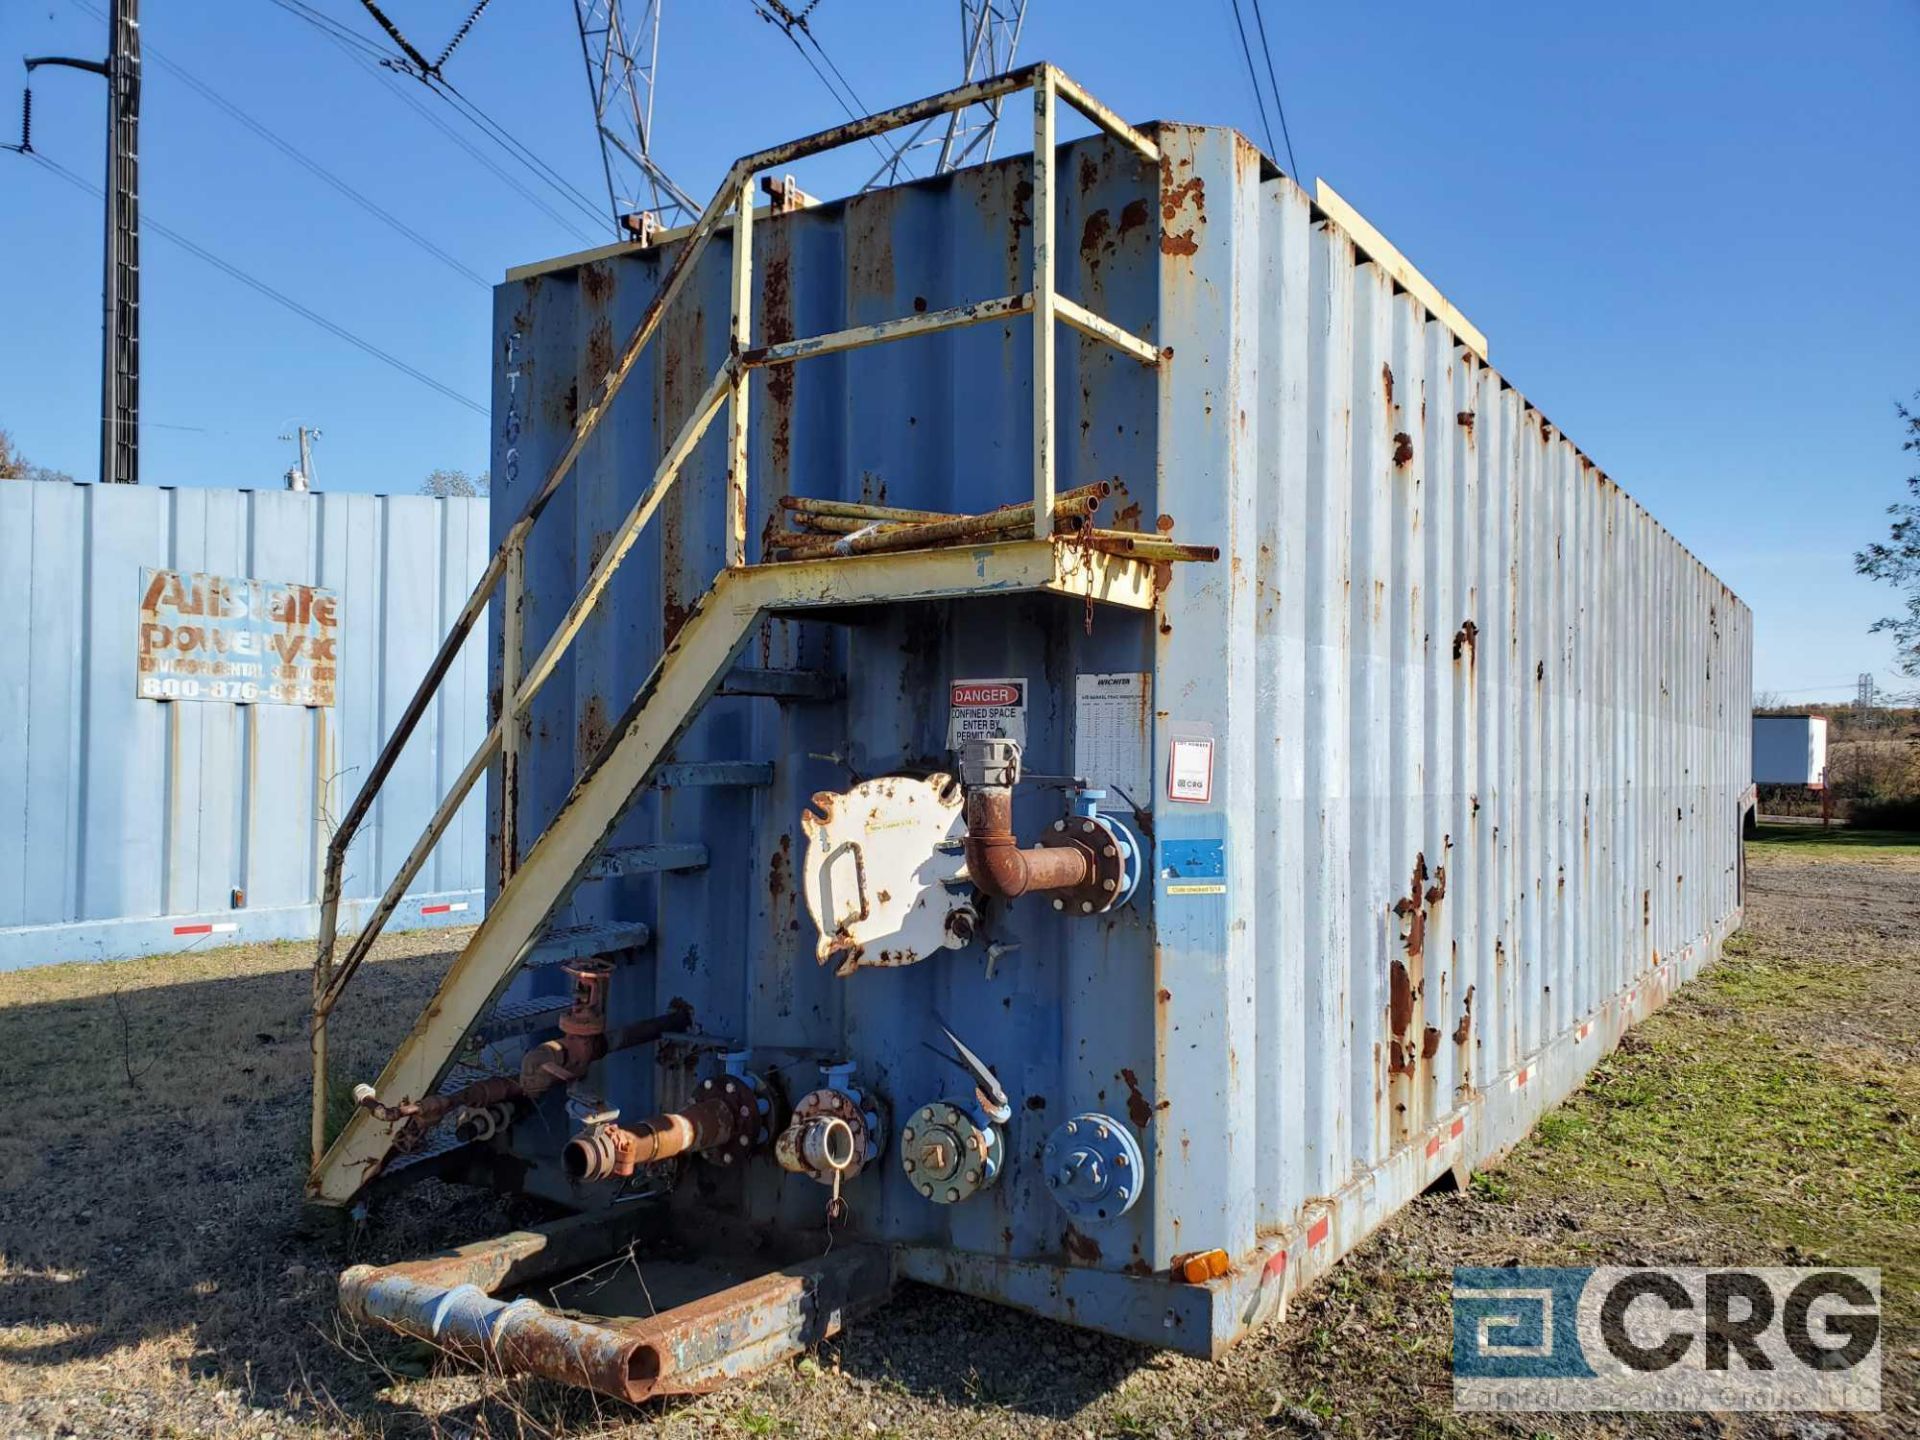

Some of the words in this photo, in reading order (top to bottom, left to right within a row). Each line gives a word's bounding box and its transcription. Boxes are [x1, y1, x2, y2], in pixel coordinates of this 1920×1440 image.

[1097, 678, 1131, 686] WICHITA
[954, 689, 1009, 702] DANGER
[951, 708, 988, 719] CONFINED
[989, 707, 1017, 718] SPACE
[963, 720, 988, 730] ENTER
[989, 719, 1000, 730] BY
[956, 731, 984, 741] PERMIT
[1186, 780, 1203, 788] CRG
